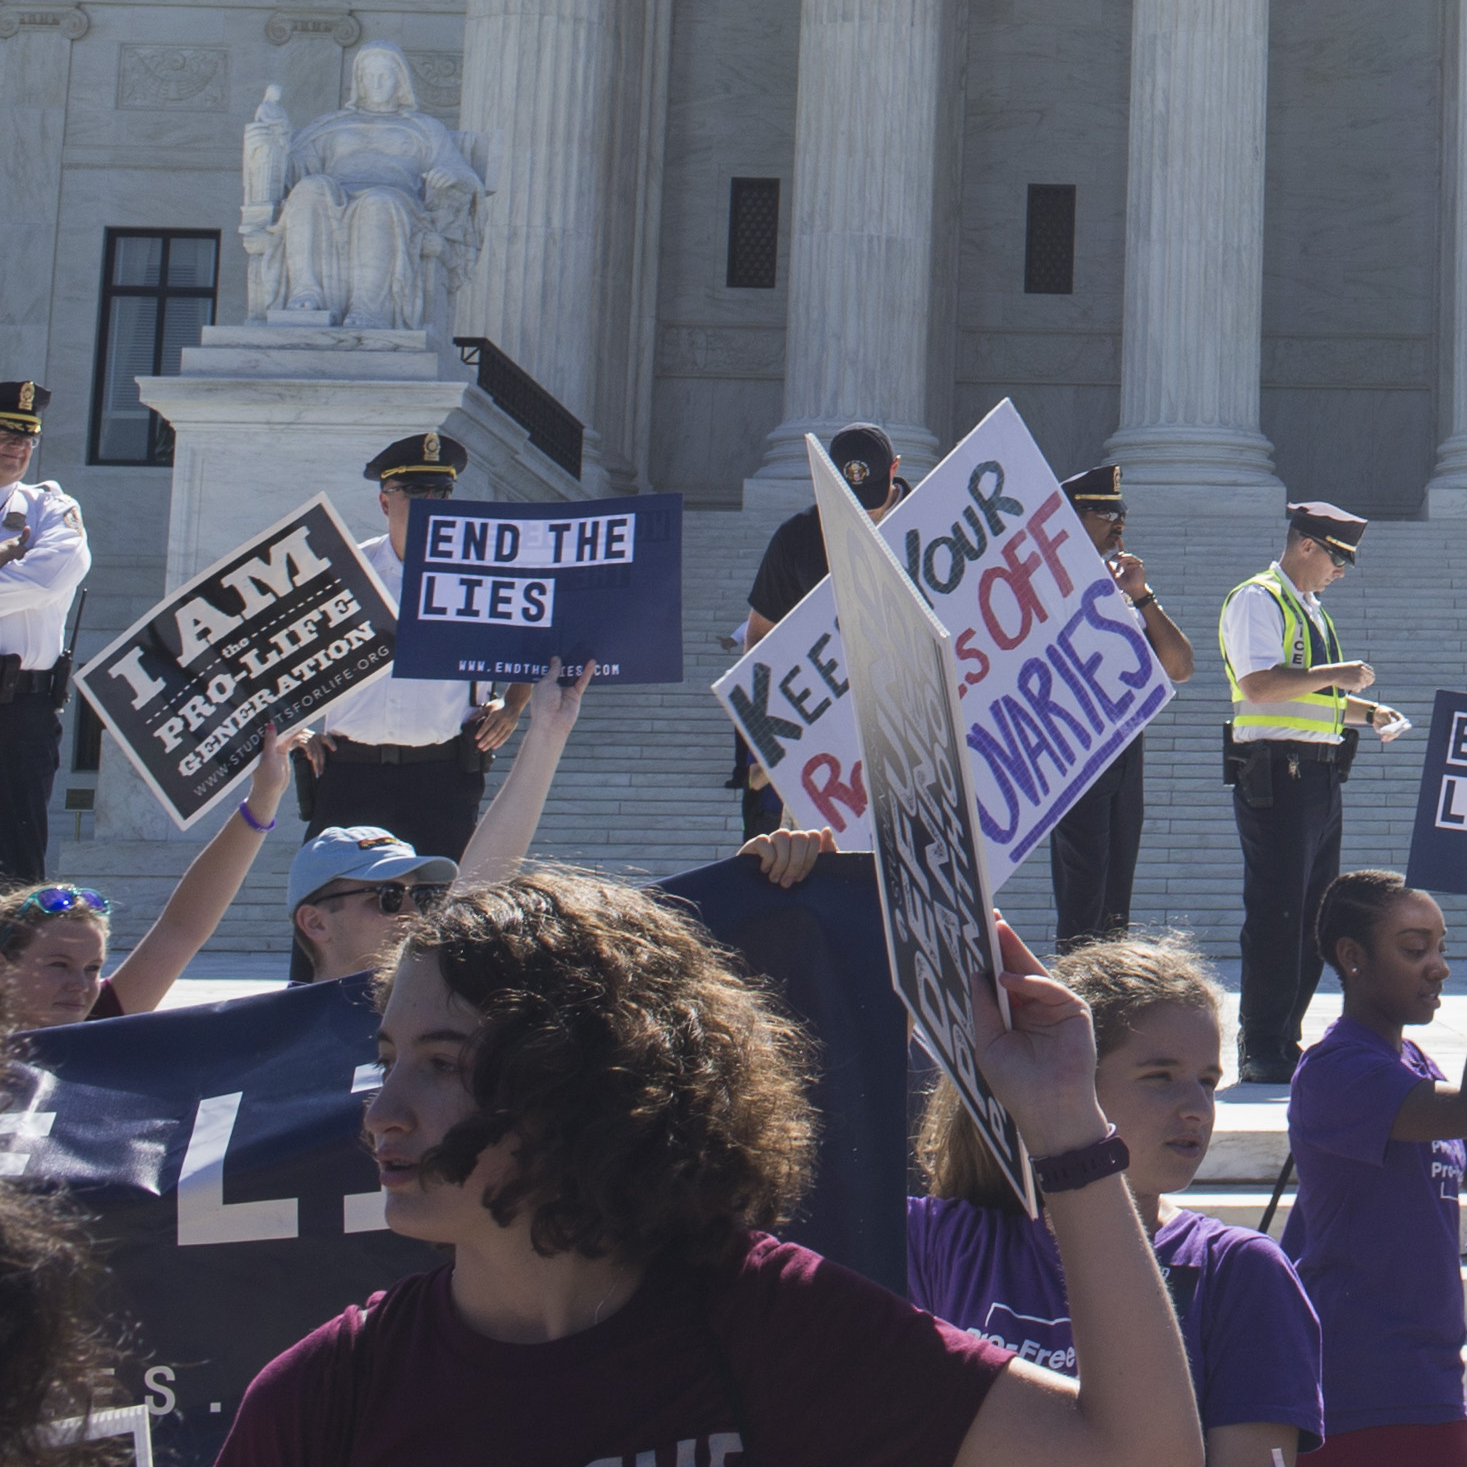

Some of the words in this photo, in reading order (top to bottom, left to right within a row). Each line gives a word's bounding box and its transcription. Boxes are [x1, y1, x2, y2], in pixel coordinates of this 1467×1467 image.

[422, 575, 548, 623] LIES
[428, 519, 520, 563] END
[548, 518, 628, 564] THE
[901, 459, 1025, 610] YOUR
[977, 491, 1070, 651] OFF
[107, 645, 167, 711] I
[174, 525, 333, 669] AM
[153, 588, 362, 754] PRO-LIFE
[222, 637, 250, 661] the
[728, 618, 850, 769] KEE
[178, 621, 377, 778] GENERATION
